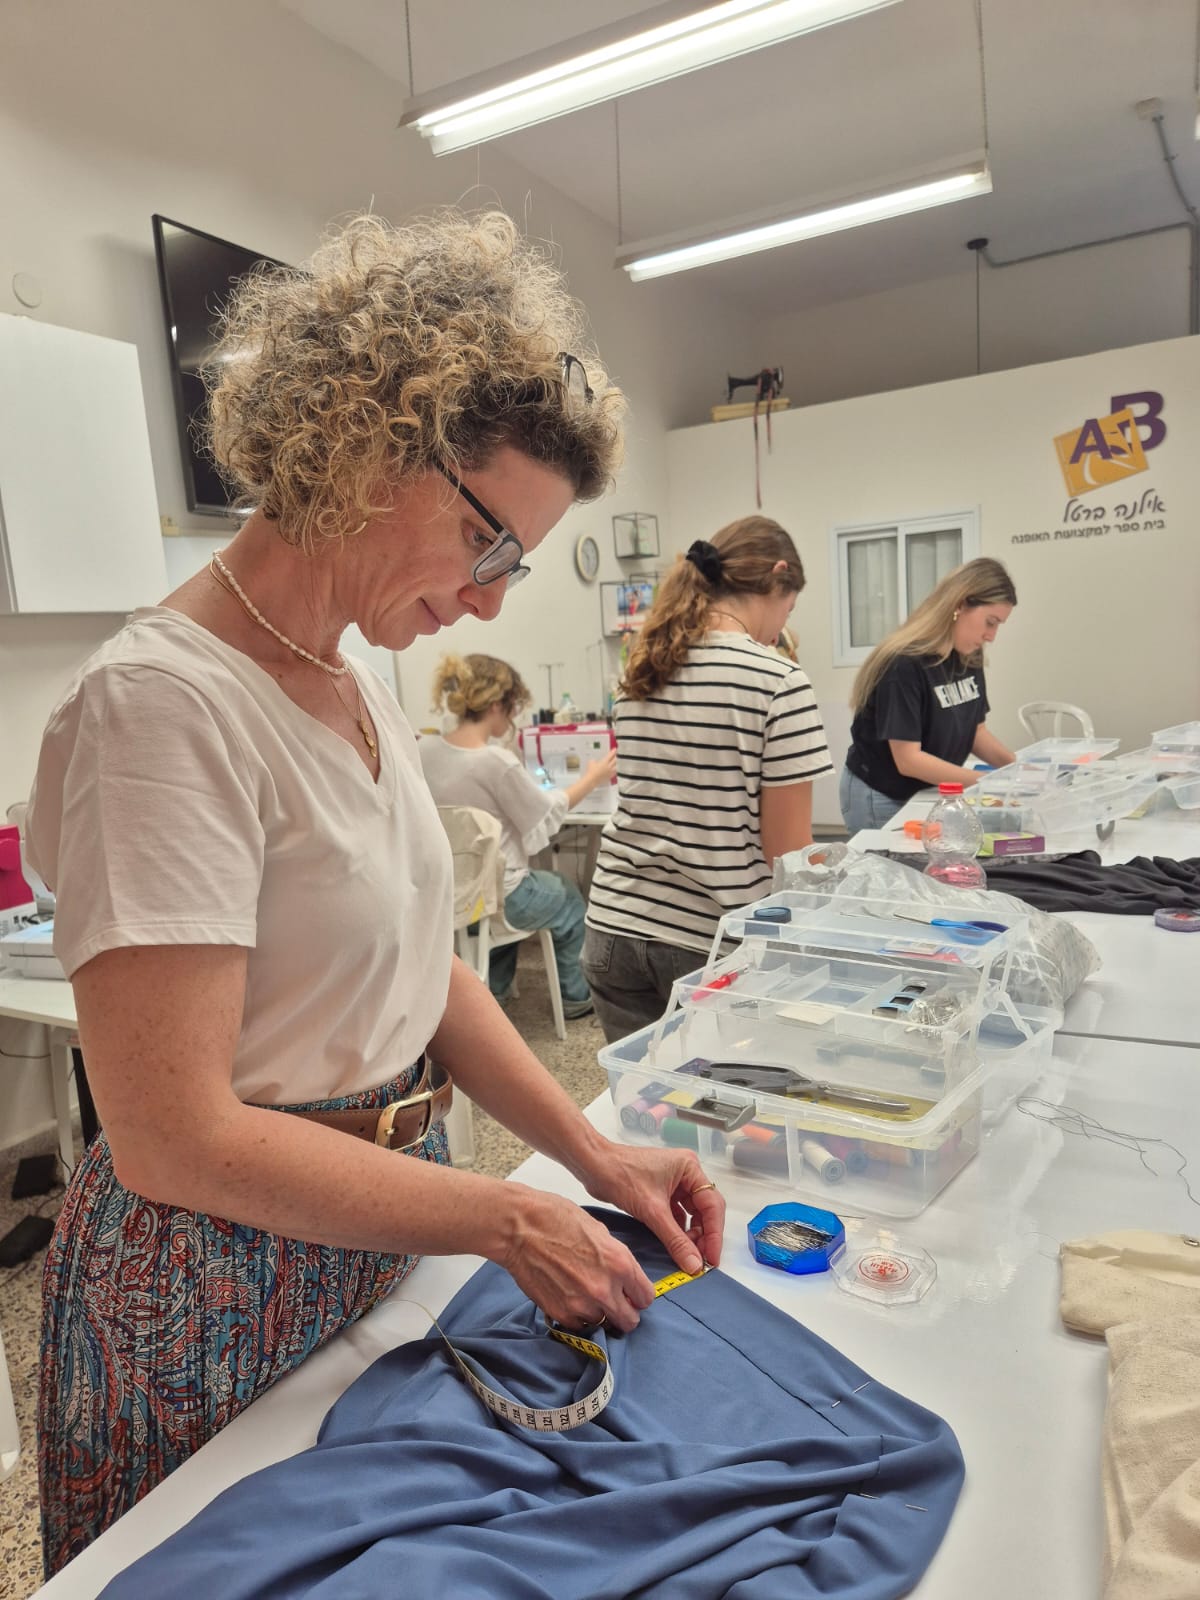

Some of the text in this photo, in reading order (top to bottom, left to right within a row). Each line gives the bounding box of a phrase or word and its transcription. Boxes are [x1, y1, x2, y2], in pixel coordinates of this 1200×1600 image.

[1063, 488, 1167, 523] אילנה ברטל
[1011, 518, 1166, 544] בית ספר למקצועות האופנה
[591, 1397, 599, 1411] 124
[526, 1414, 535, 1425] 120
[544, 1415, 553, 1427] 121
[559, 1413, 569, 1426] 122
[577, 1407, 586, 1421] 123
